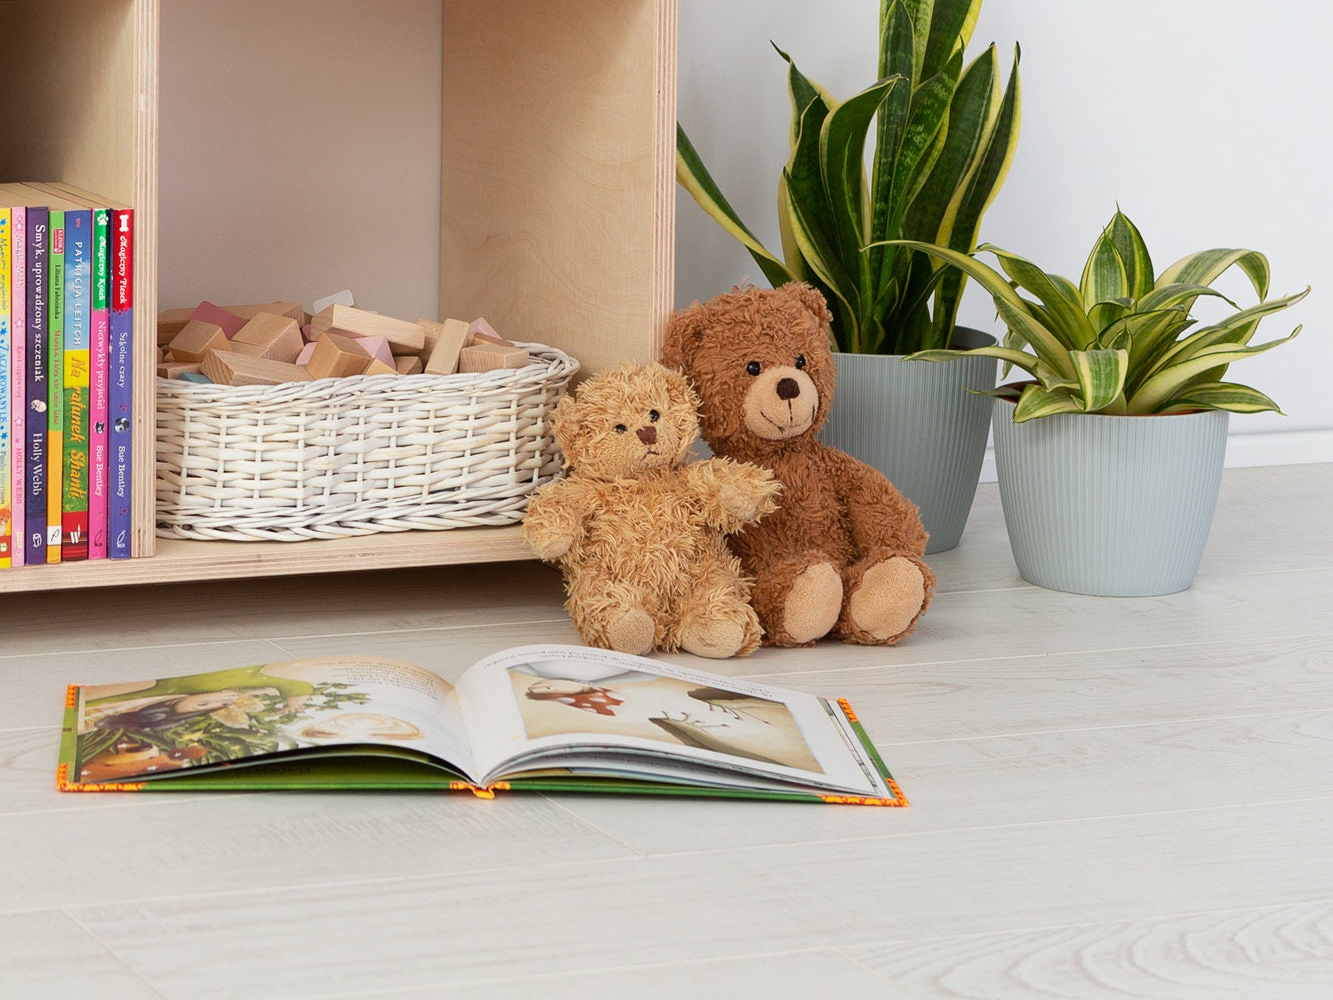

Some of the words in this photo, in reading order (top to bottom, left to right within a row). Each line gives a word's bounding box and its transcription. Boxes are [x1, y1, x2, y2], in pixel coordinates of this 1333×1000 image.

[73, 241, 83, 299] PATRICIA
[32, 262, 45, 330] uprowadzony
[73, 303, 82, 346] LEITCH
[33, 333, 45, 382] szczeniak
[96, 321, 107, 368] Niezwykły
[118, 332, 128, 364] Szkolne
[70, 356, 87, 378] Na
[116, 366, 126, 388] czary
[96, 370, 106, 410] przyjaciel
[70, 385, 86, 443] ratunek
[15, 447, 23, 475] HOLLY
[30, 432, 42, 462] Holly
[96, 445, 104, 462] Sue
[117, 445, 126, 463] Sue
[32, 464, 42, 496] Webb
[69, 448, 86, 500] Shanti
[95, 464, 104, 497] Bentley
[116, 464, 126, 498] Bentley
[15, 478, 23, 505] WEBB
